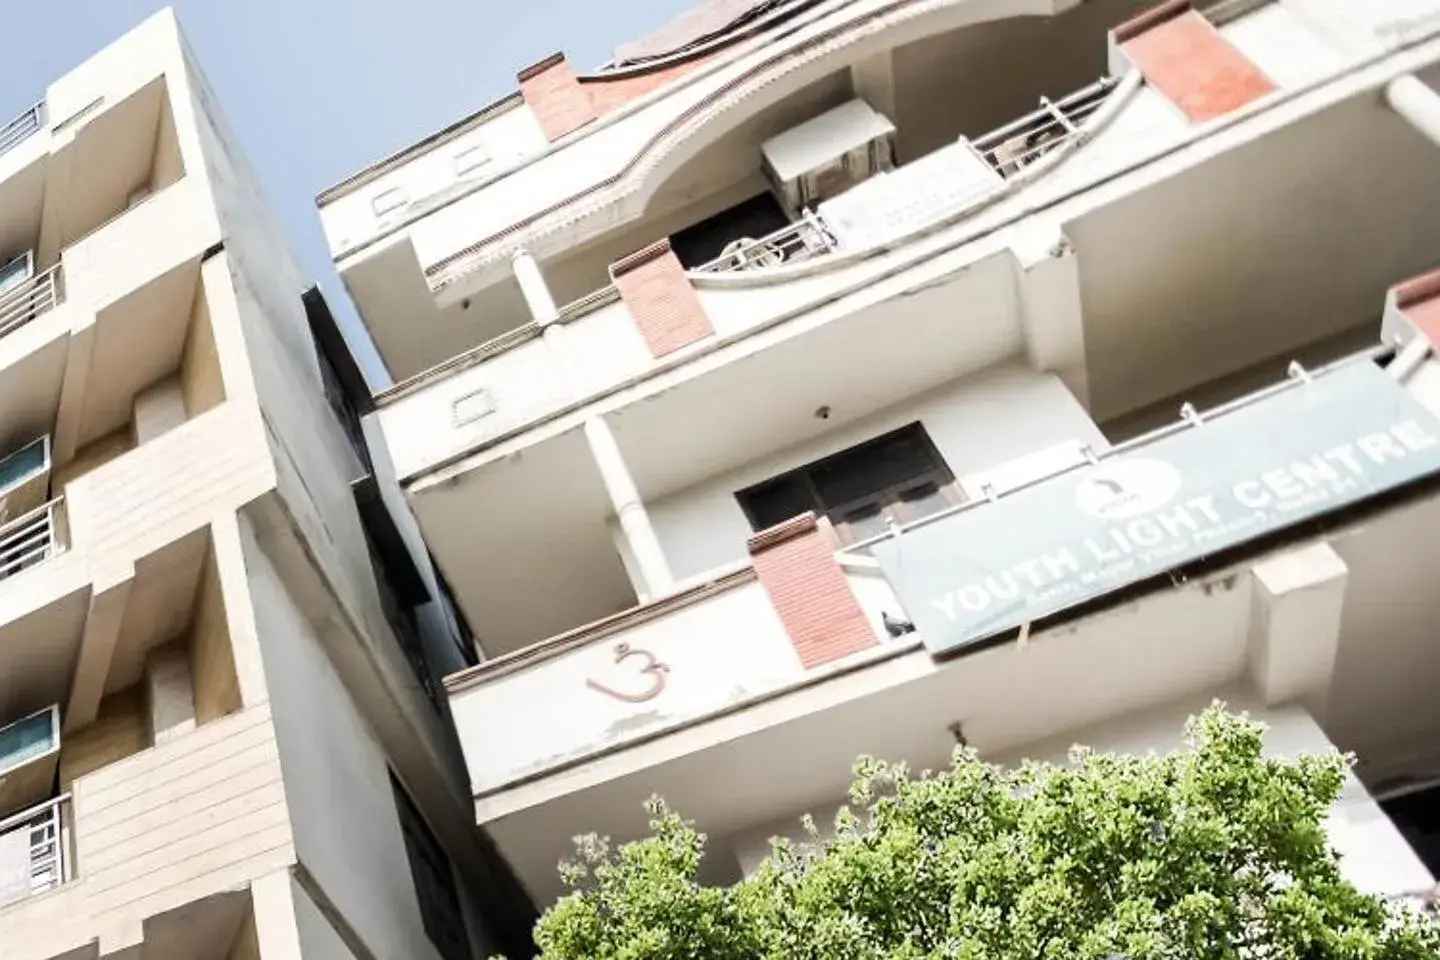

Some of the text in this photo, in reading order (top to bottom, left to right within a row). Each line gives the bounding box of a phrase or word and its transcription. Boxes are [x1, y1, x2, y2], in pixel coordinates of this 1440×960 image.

[929, 545, 1080, 620] YOUTH
[1083, 493, 1221, 565] LIGHT
[1232, 419, 1437, 508] CENTRE
